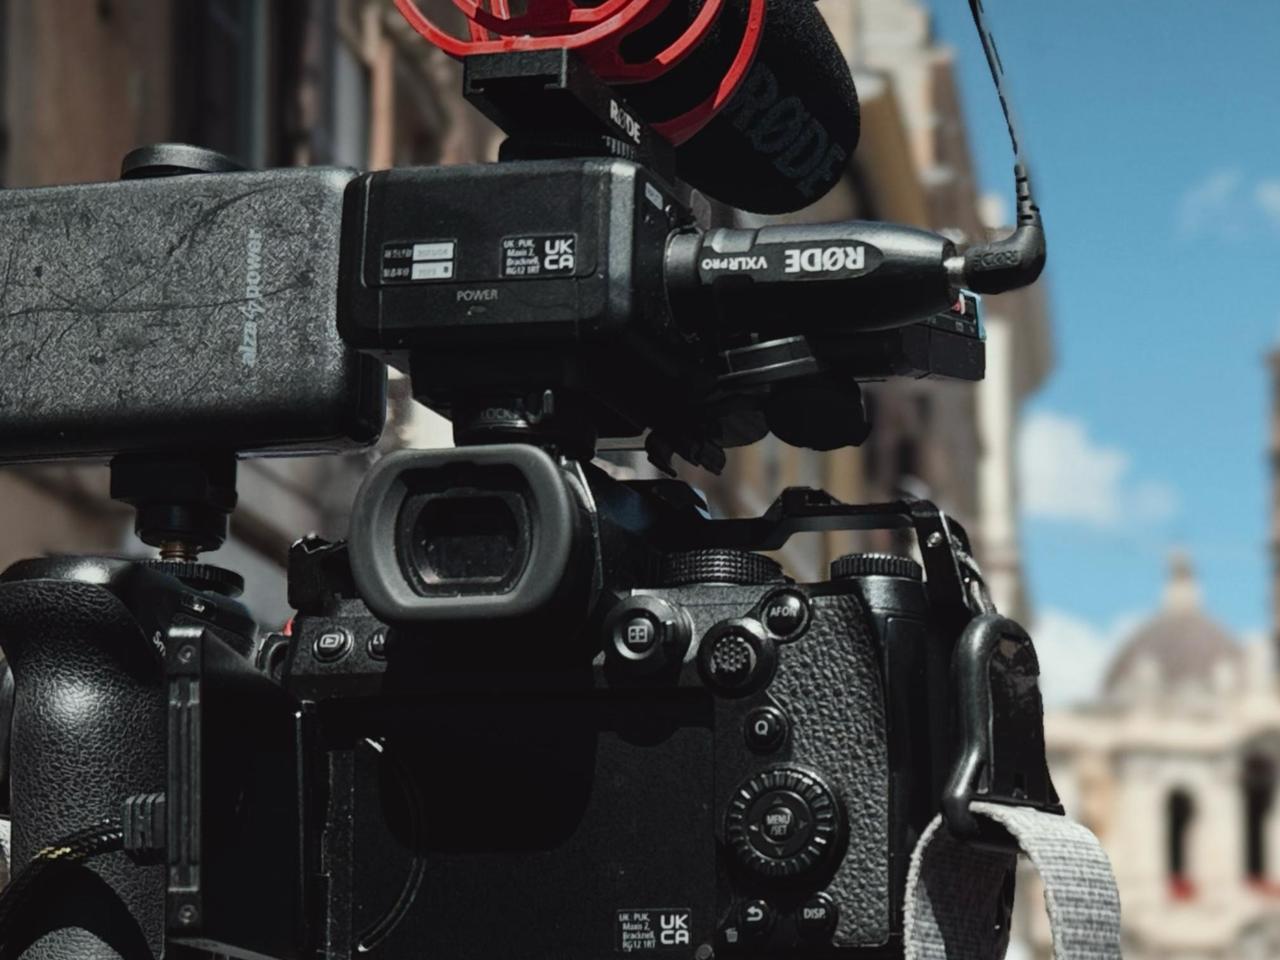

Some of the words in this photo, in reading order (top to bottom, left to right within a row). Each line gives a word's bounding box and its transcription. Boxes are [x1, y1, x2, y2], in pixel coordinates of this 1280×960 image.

[610, 99, 640, 144] RØDE
[544, 238, 574, 254] UK
[544, 254, 574, 271] CA
[784, 246, 865, 274] RØDE
[456, 289, 499, 302] POWER
[754, 720, 768, 737] Q
[766, 814, 791, 825] MENU
[660, 913, 689, 929] UK
[660, 929, 690, 945] CA
